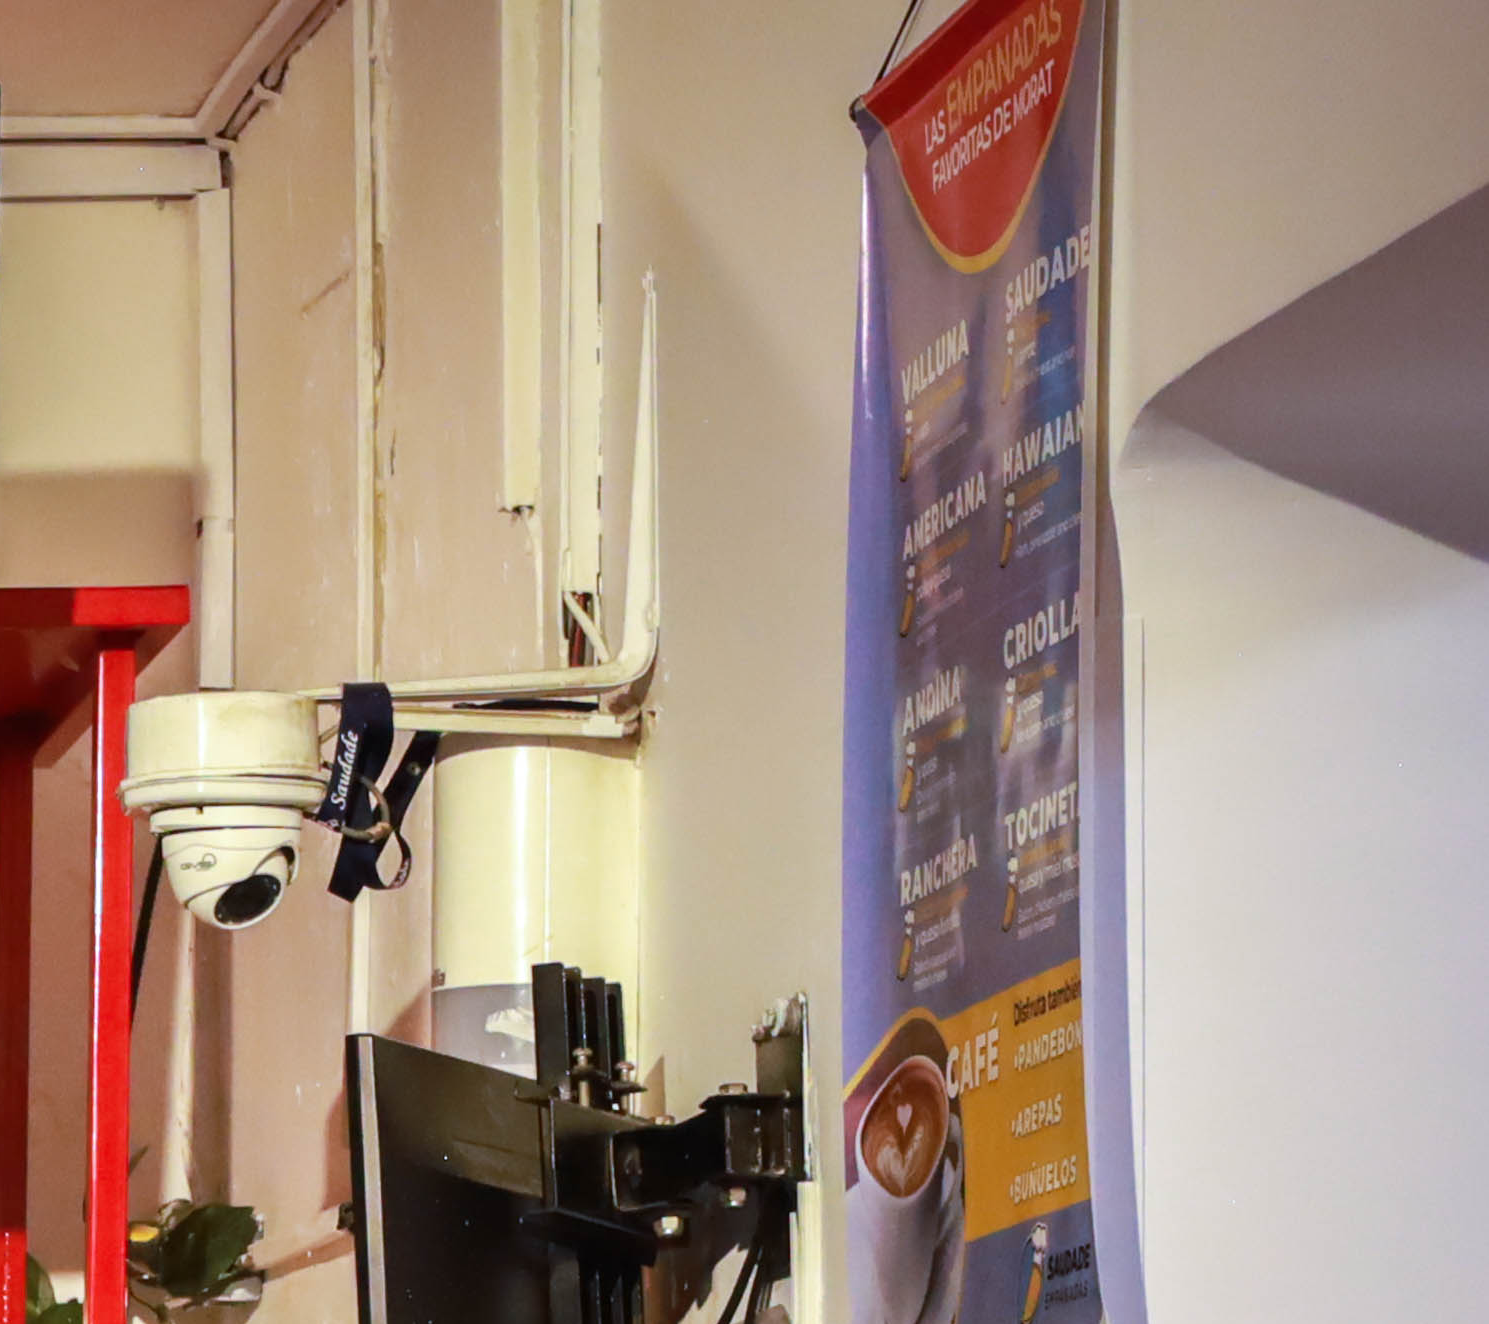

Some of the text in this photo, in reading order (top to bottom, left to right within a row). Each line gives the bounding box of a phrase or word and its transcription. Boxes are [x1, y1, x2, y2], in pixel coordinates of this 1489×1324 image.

[924, 0, 1062, 155] LAS EMPANADAS
[932, 58, 1055, 195] FAVORITAS DE MORAT
[1005, 225, 1091, 324] SAUDADE
[901, 319, 969, 404] VALLUNA
[1003, 404, 1082, 487] HAWAIAN
[902, 471, 987, 561] AMERICANA
[1003, 591, 1081, 669] CRIOLLA
[903, 665, 961, 737] ANDINA
[1004, 781, 1079, 850] TOCINET
[900, 833, 978, 907] RANCHERA
[946, 1012, 999, 1099] CAFÉ
[1018, 1020, 1082, 1072] PANDEBON
[1015, 1094, 1062, 1137] AREPAS
